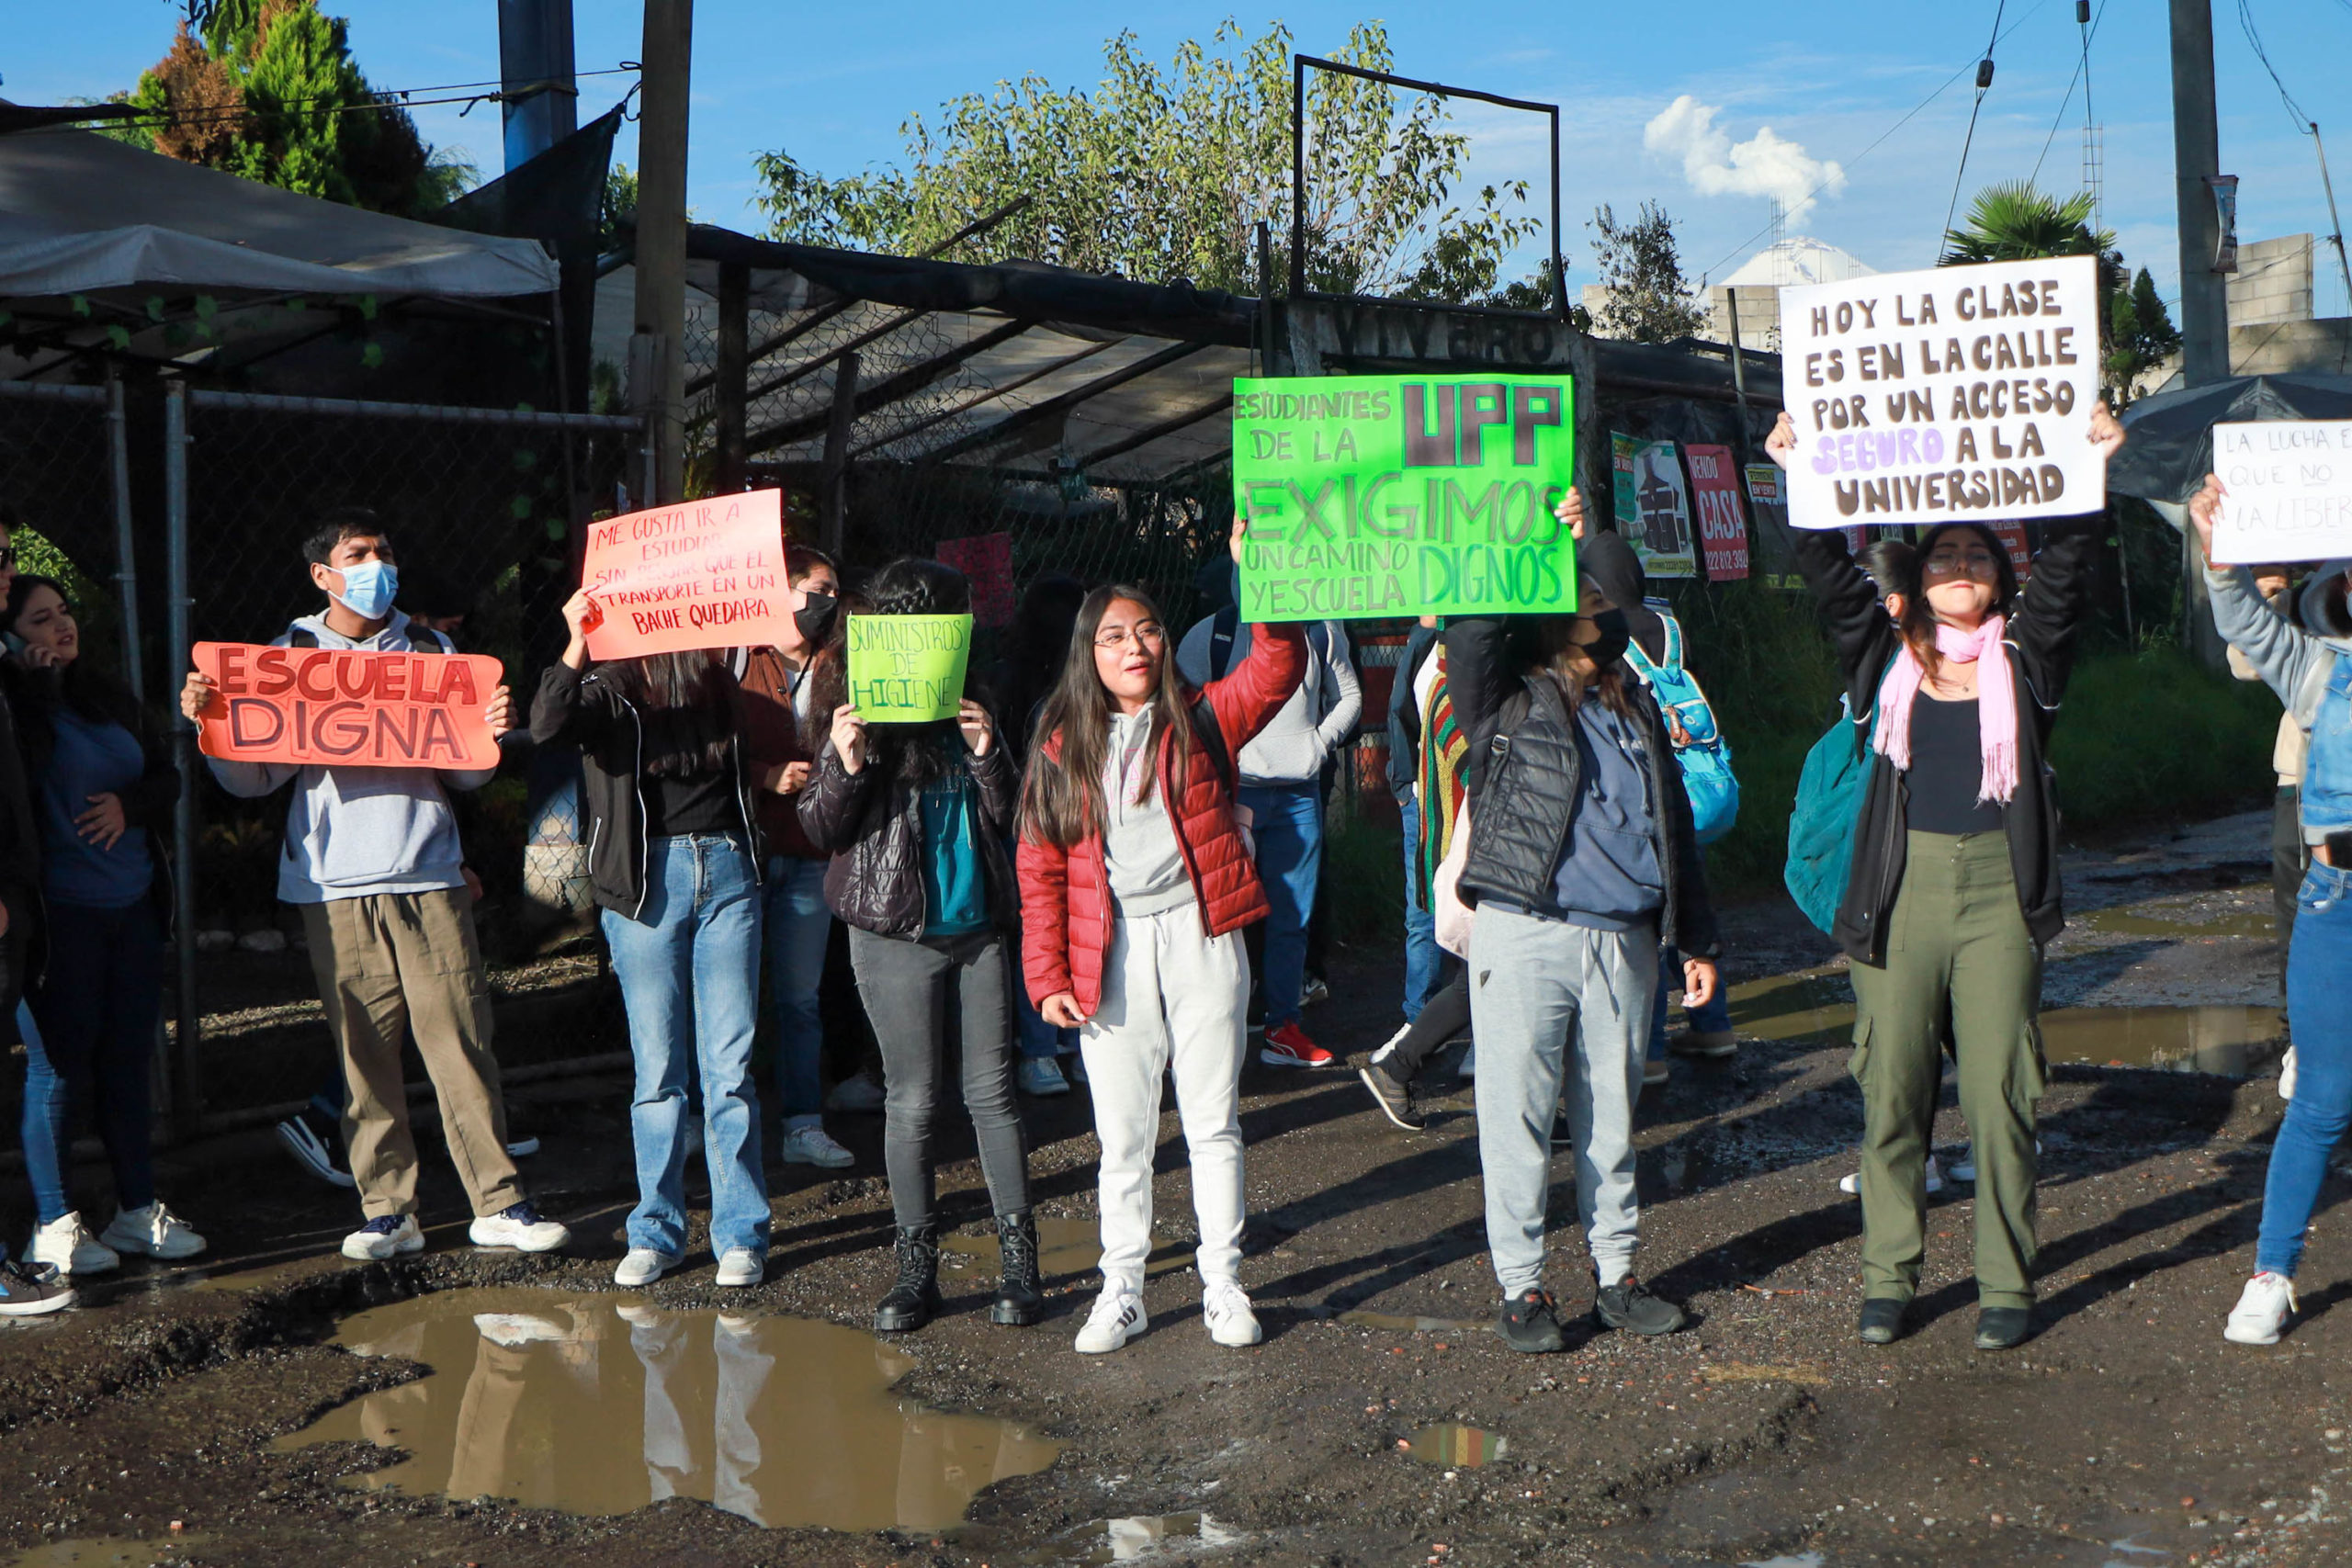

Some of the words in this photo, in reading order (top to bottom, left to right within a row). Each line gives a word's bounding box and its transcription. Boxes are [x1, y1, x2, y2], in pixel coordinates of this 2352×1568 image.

[1811, 298, 1878, 337] HOY
[1895, 293, 1938, 326] LA
[1955, 279, 2062, 321] CLASE
[1805, 349, 1844, 387] ES
[1857, 342, 1905, 381] EN
[1920, 337, 1964, 375] LA
[1971, 326, 2077, 371] CALLE
[1233, 389, 1392, 421] ESTUDIANTES
[1811, 393, 1870, 432] POR
[1886, 387, 1935, 423] UN
[1951, 377, 2075, 421] ACCESO
[1400, 382, 1562, 467] UPP
[2226, 433, 2253, 453] LA
[2267, 429, 2330, 451] LUCHA
[1250, 429, 1294, 459] DE
[1313, 427, 1358, 462] LA
[1811, 427, 1944, 475] SEGURO
[1955, 426, 1978, 463] A
[1990, 422, 2045, 459] LA
[1689, 456, 1718, 479] VENDO
[2229, 465, 2285, 486] QUE
[2300, 464, 2333, 482] NO
[1243, 471, 1562, 546] EXIGIMOS
[1834, 464, 2064, 517] UNIVERSIDAD
[595, 524, 625, 550] ME
[632, 511, 686, 541] GUSTA
[696, 506, 716, 528] IR
[726, 502, 740, 522] A
[1699, 491, 1746, 540] CASA
[2236, 507, 2266, 531] LA
[595, 569, 627, 586] SIN
[705, 555, 737, 575] QUE
[746, 550, 768, 569] EL
[1288, 540, 1409, 572] CAMINO
[1418, 544, 1562, 606] DIGNOS
[600, 581, 704, 607] TRANSPORTE
[713, 577, 736, 592] EN
[747, 574, 775, 591] UN
[1271, 574, 1406, 615] ESCUELA
[631, 607, 684, 636] BACHE
[849, 618, 964, 652] SUMINISTROS
[218, 647, 478, 705] ESCUELA
[889, 652, 919, 675] DE
[853, 677, 952, 709] HIGIENE
[230, 698, 464, 761] DIGNA
